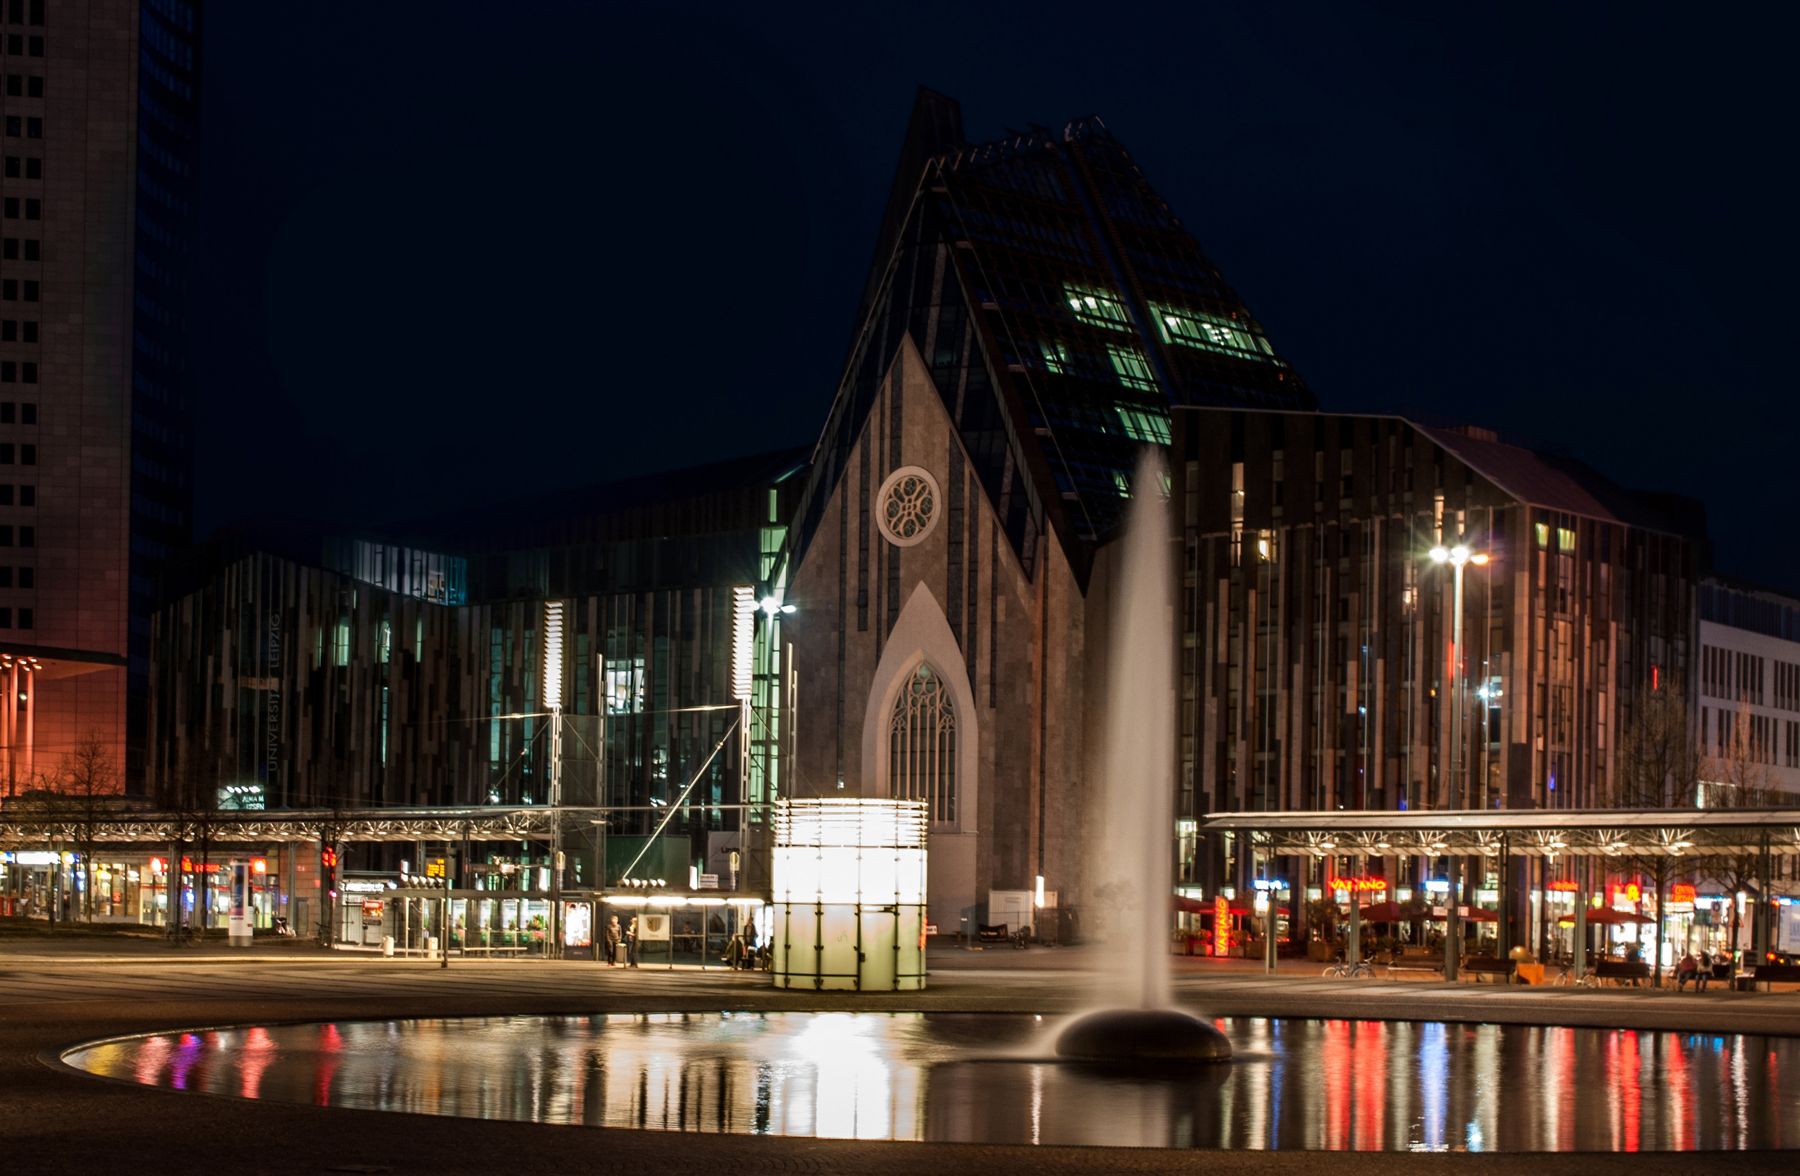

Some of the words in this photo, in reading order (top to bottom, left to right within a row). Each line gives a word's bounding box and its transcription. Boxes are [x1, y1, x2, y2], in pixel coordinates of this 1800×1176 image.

[269, 613, 281, 668] LEIPZIG
[268, 672, 280, 772] UNIVERSIT
[1217, 899, 1228, 953] VAPIANO
